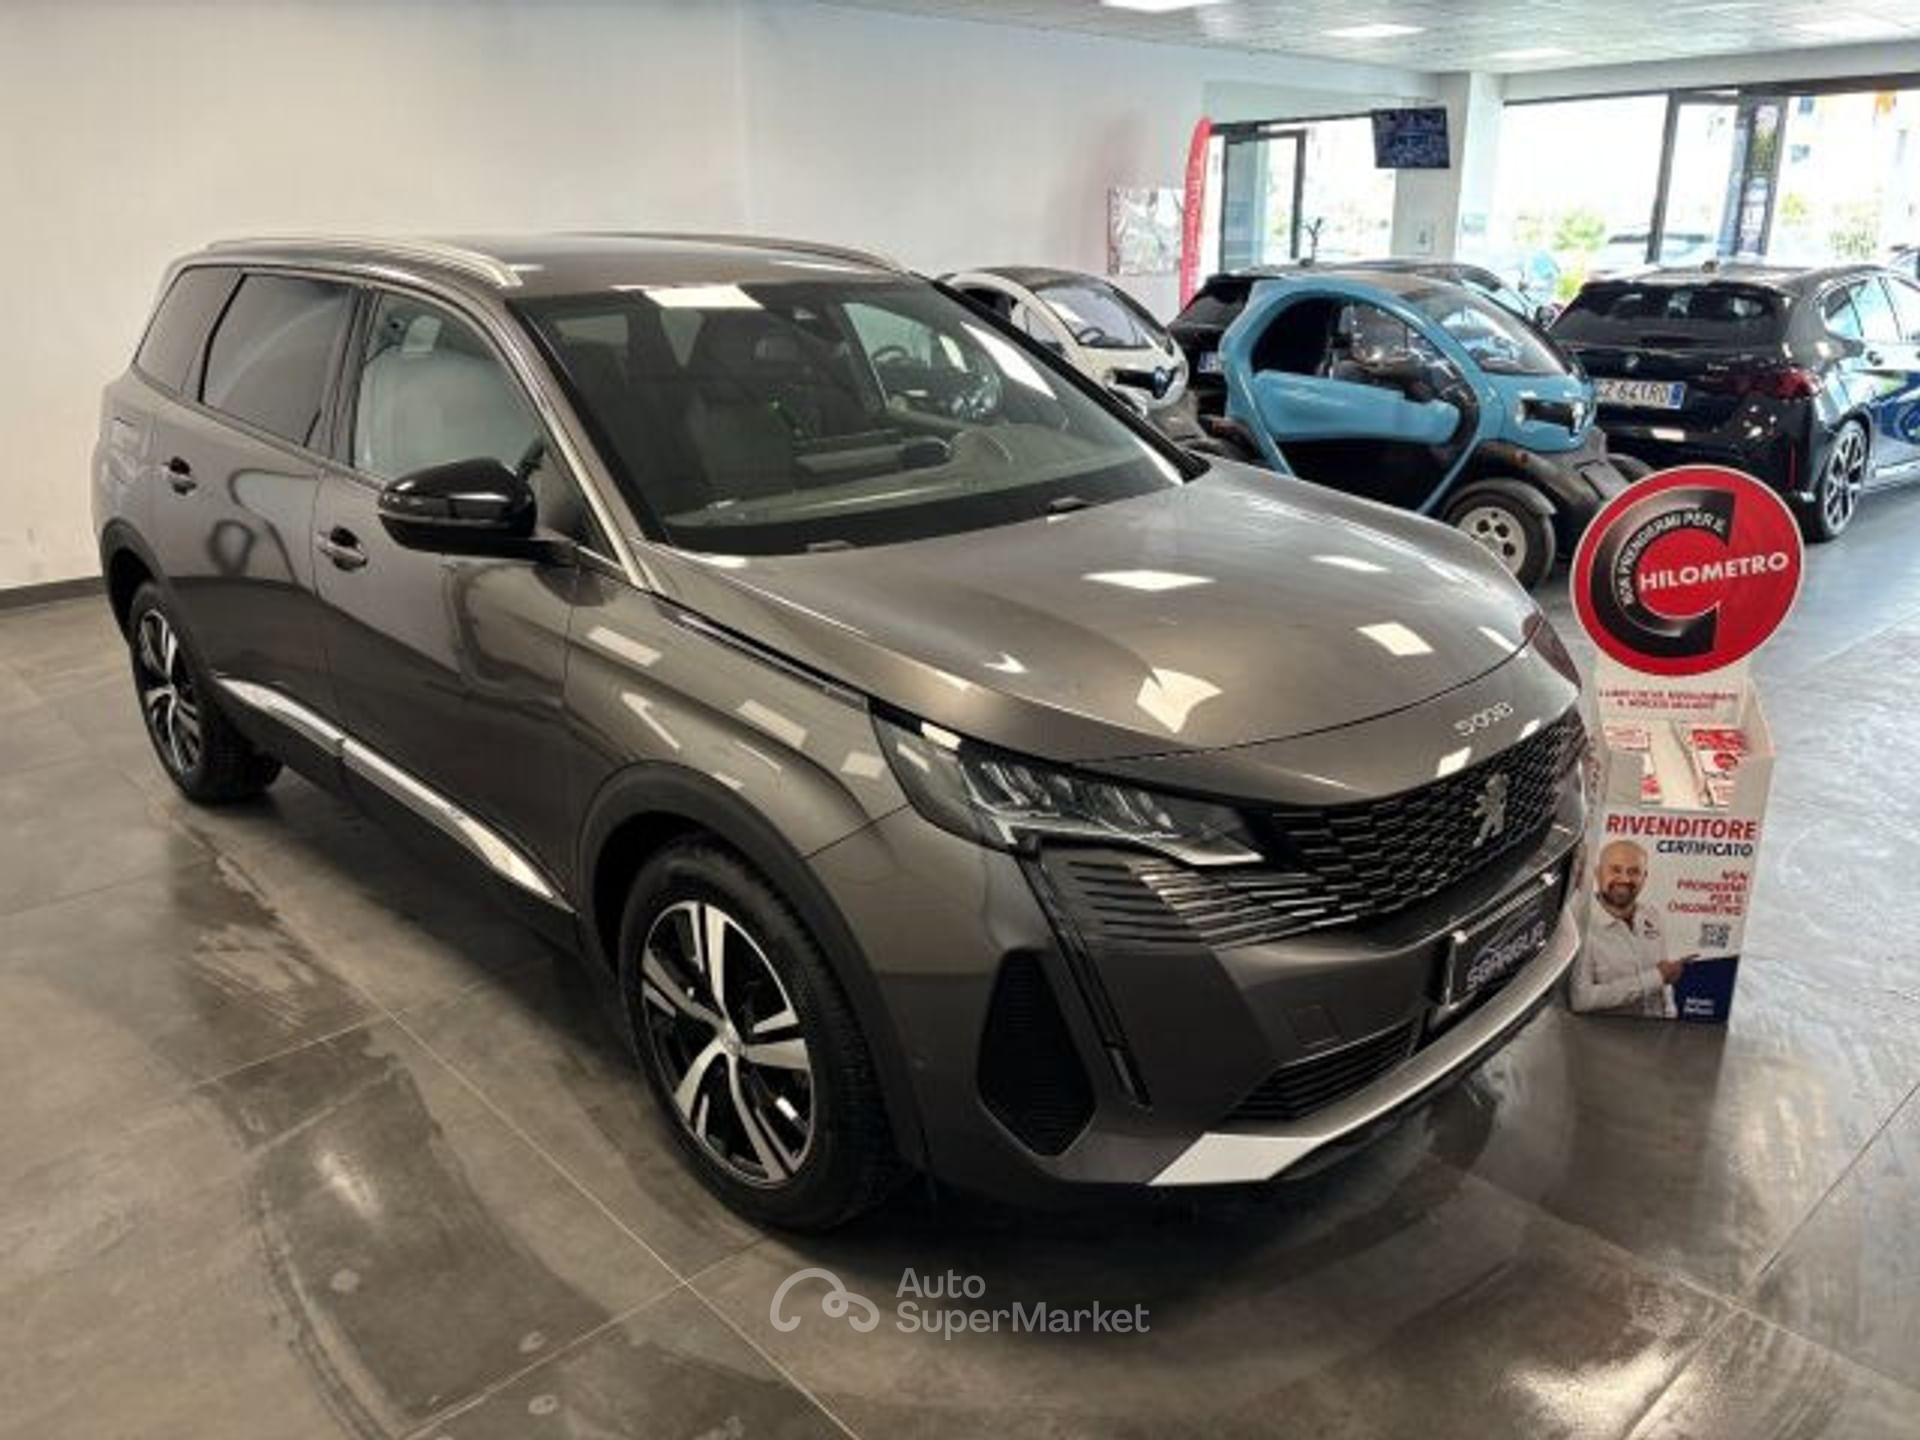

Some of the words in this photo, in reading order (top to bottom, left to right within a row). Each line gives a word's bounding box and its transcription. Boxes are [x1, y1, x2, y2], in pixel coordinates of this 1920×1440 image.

[1682, 511, 1715, 528] PER
[1605, 813, 1758, 840] RIVENDITORE
[1656, 840, 1754, 858] CERTIFICATO
